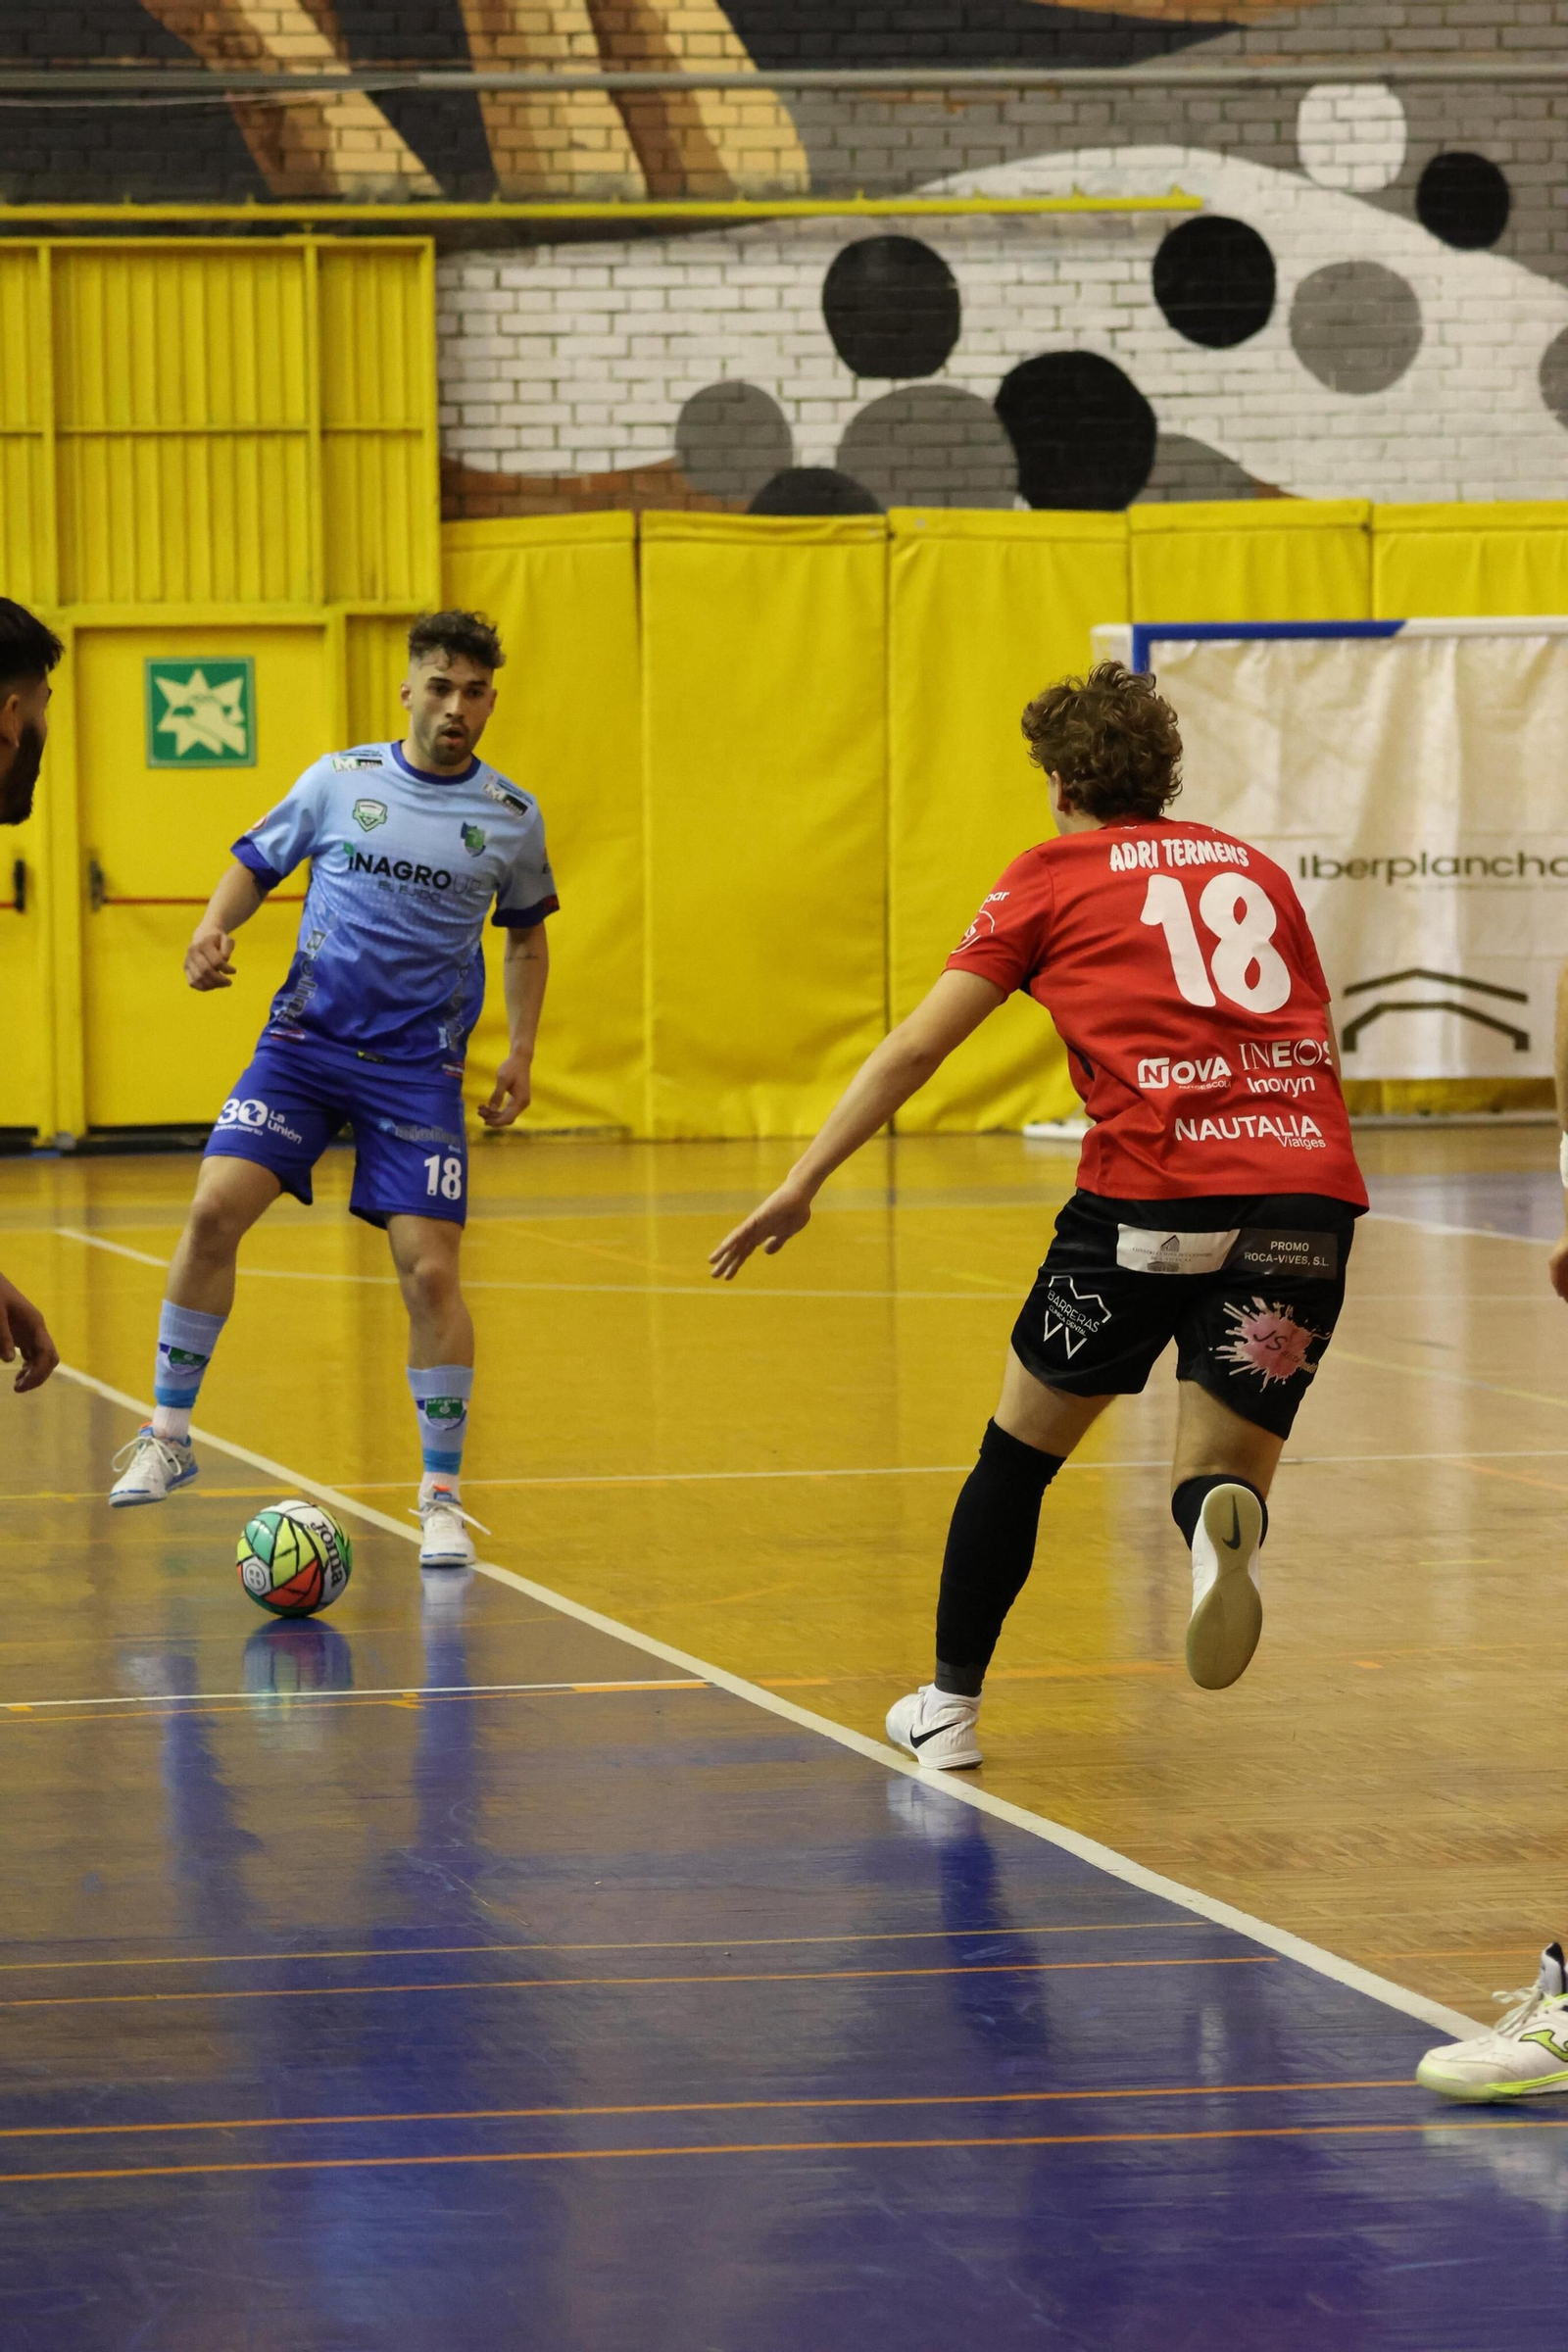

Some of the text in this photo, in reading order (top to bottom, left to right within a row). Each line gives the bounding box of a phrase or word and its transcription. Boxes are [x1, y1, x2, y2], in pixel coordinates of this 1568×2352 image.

[1109, 838, 1250, 872] ADRI TERMENS
[1140, 871, 1292, 1014] 18
[1138, 1056, 1232, 1089] NOVA
[217, 1098, 269, 1127] 30
[1175, 1115, 1323, 1142] NAUTALIA
[1277, 1135, 1326, 1150] Viatges
[423, 1153, 462, 1200] 18
[1270, 1241, 1309, 1251] PROMO
[1047, 1290, 1100, 1333] BARRERAS
[1065, 1319, 1087, 1337] DENTAL
